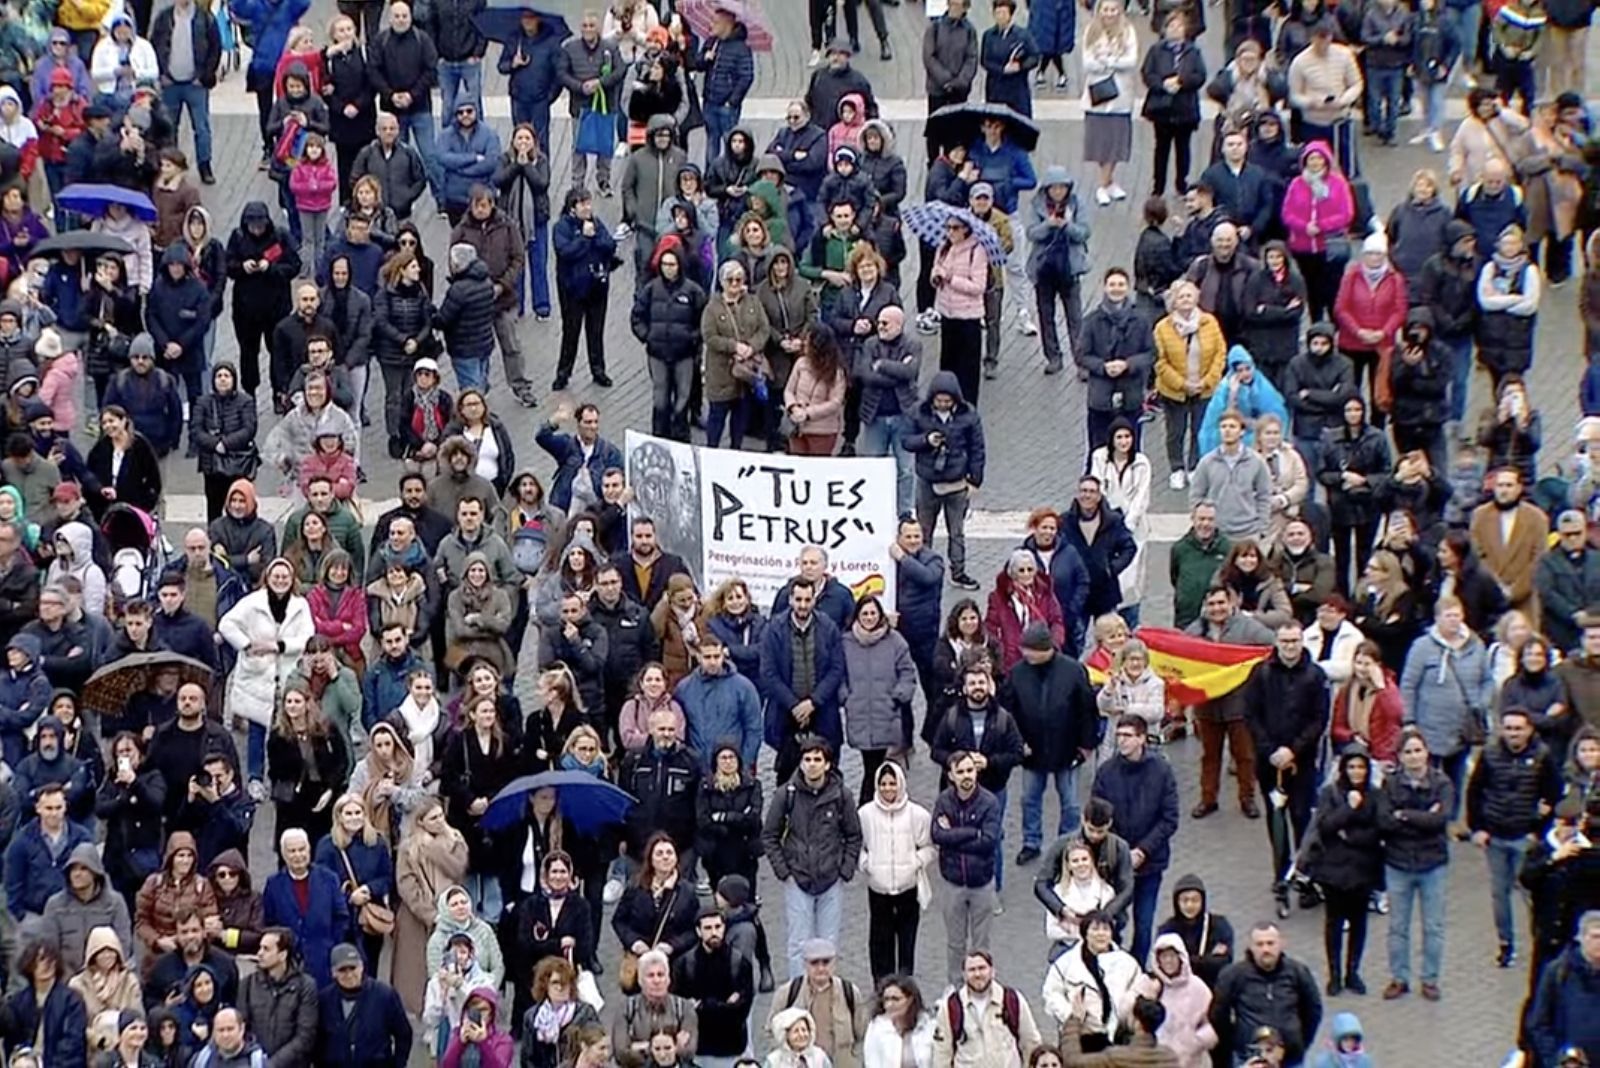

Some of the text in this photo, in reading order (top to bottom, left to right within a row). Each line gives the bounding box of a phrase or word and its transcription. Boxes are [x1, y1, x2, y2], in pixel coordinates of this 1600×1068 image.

[828, 479, 866, 510] ES
[708, 549, 783, 567] Peregrinación
[785, 559, 792, 568] a
[831, 562, 838, 572] y
[841, 560, 880, 571] Loreto
